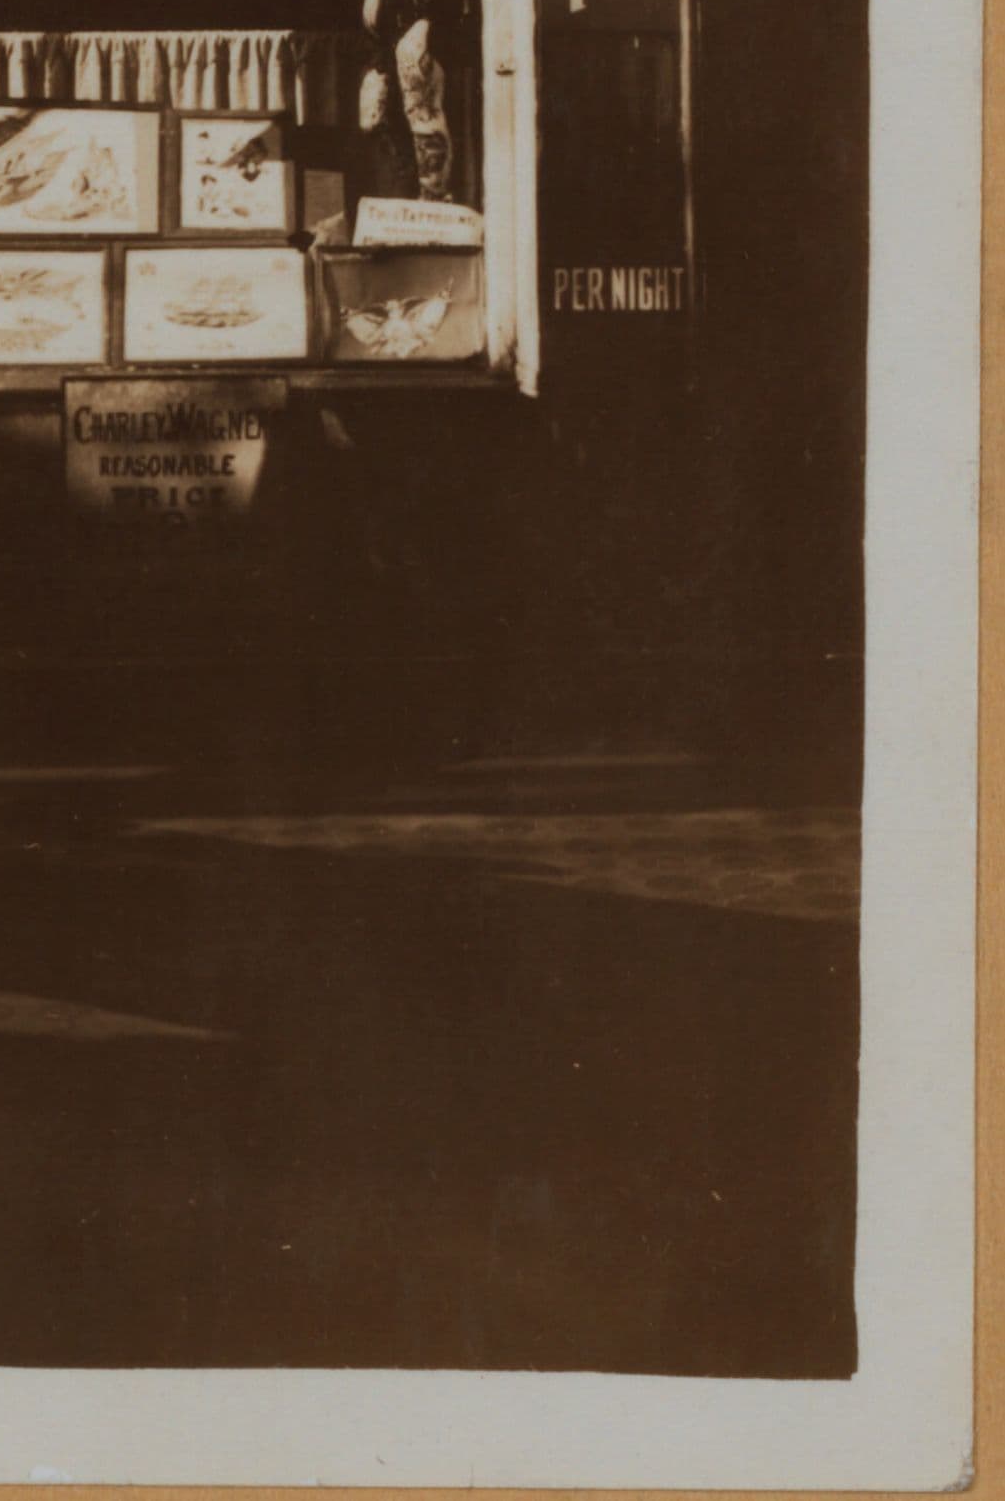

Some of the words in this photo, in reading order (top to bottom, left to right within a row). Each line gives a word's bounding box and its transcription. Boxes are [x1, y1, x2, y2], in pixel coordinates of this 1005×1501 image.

[553, 267, 605, 311] PER
[611, 266, 684, 311] NIGHT
[99, 455, 236, 478] REASONABLE
